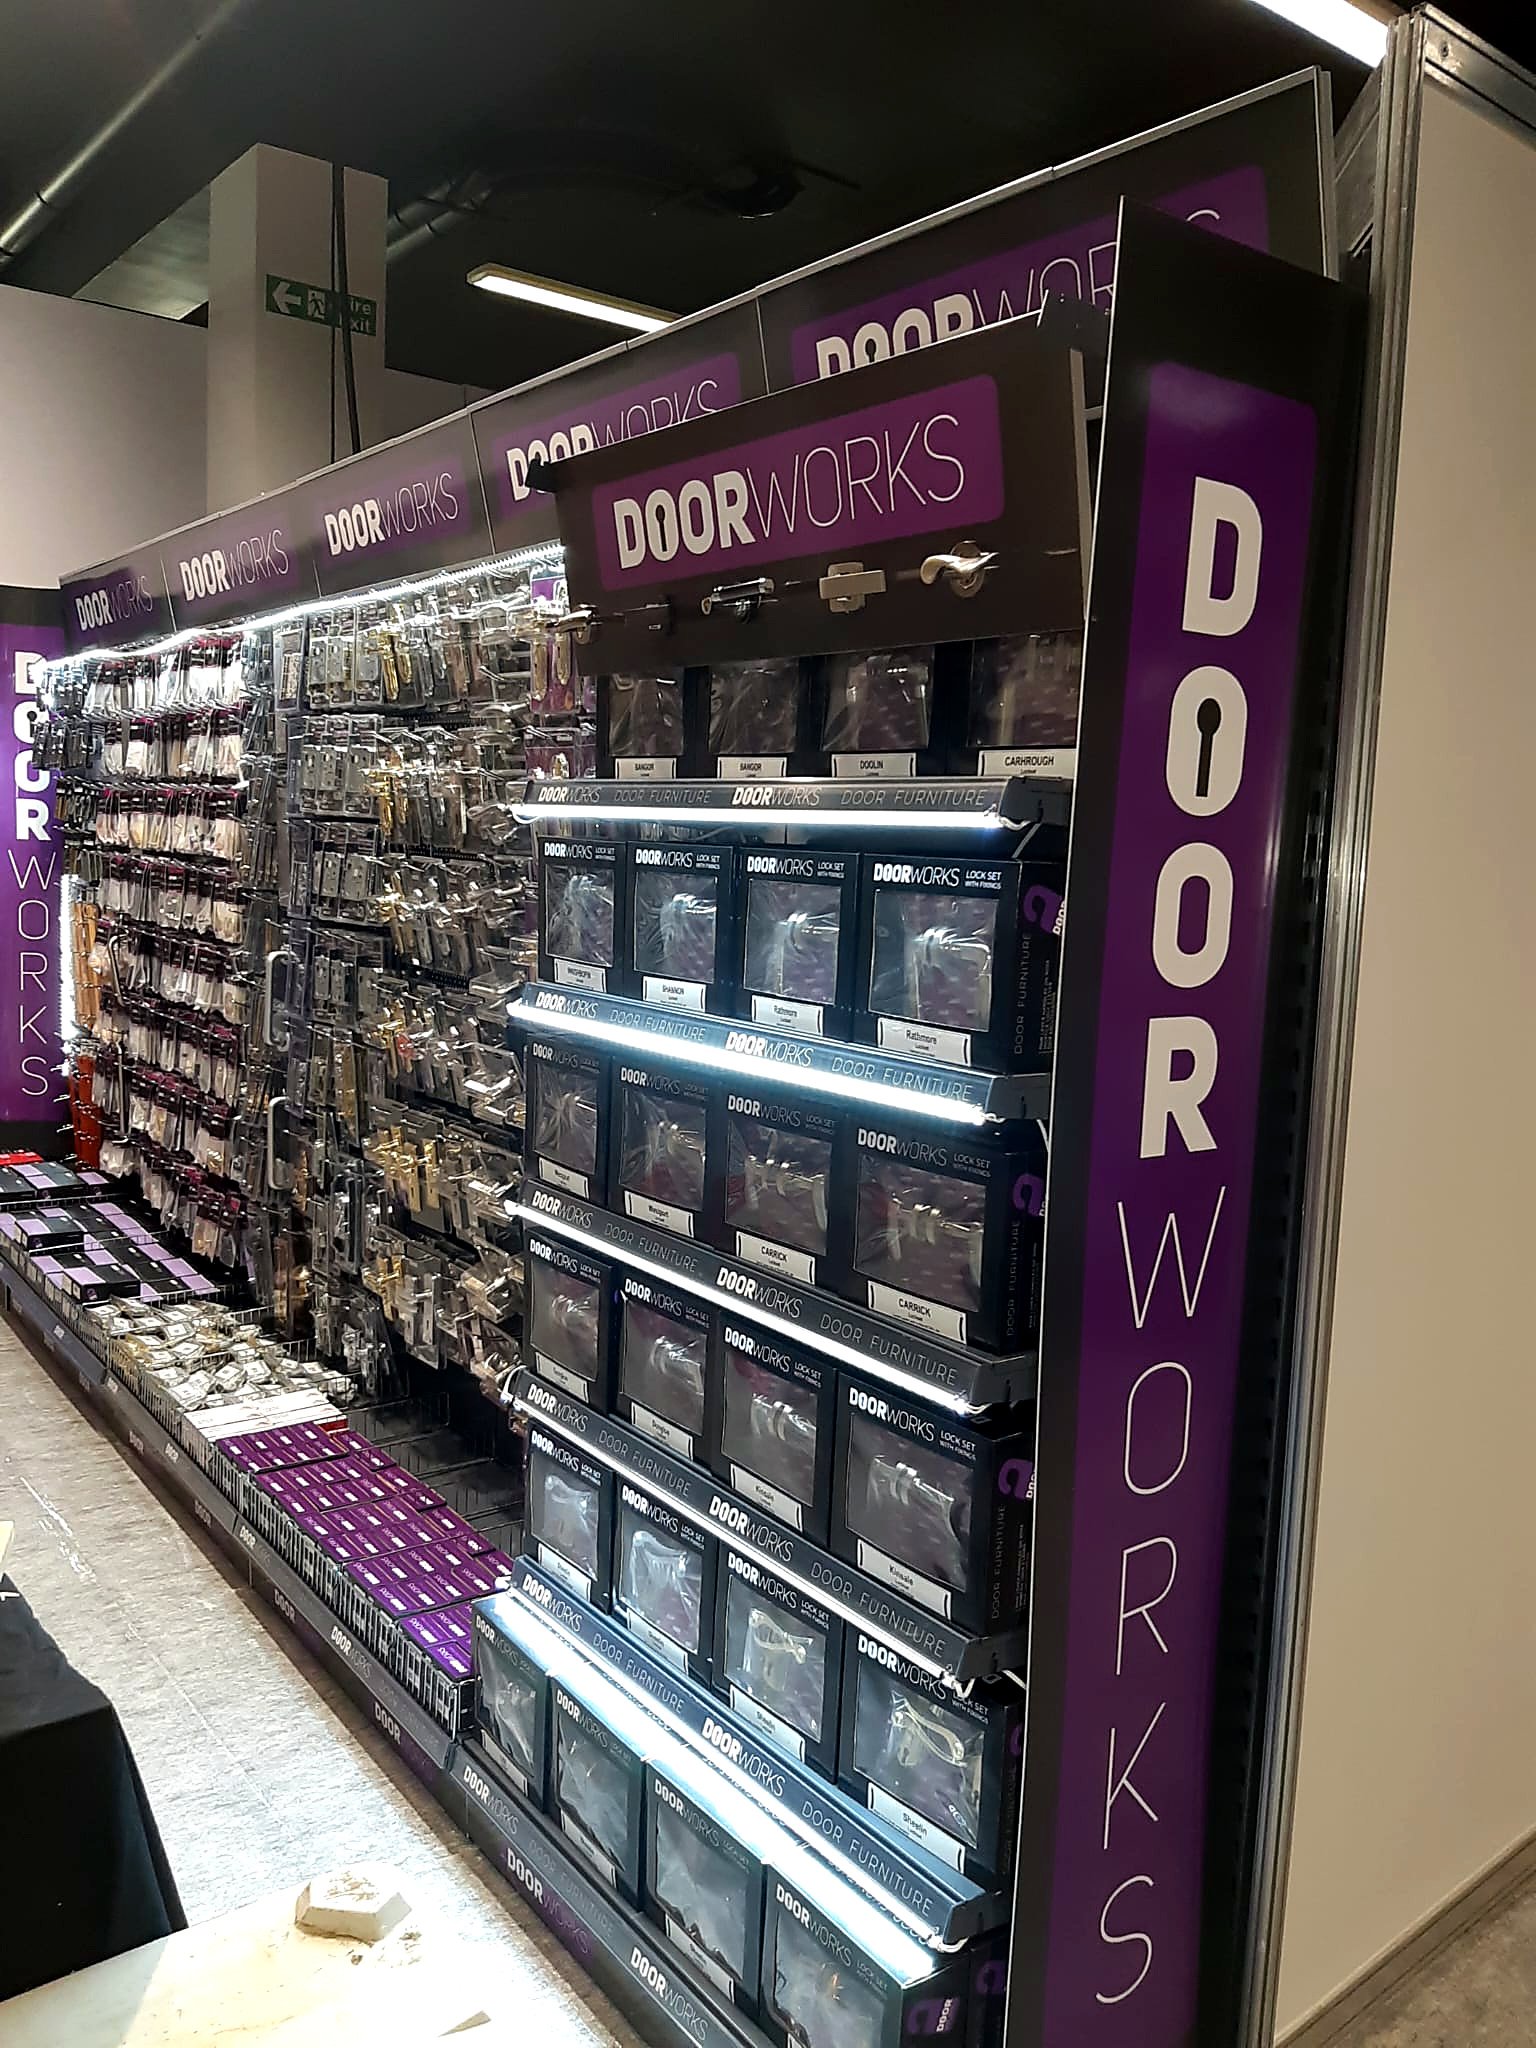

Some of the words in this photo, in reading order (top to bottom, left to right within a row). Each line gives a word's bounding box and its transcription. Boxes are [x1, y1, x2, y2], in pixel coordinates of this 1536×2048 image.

[613, 414, 964, 570] DOORWORKS
[324, 473, 458, 556] DOORWORKS
[179, 529, 289, 602] DOORWORKS
[76, 575, 153, 631] DOORWORKS
[860, 760, 884, 770] DOOLIN
[538, 786, 600, 803] DOORWORKS
[615, 790, 644, 802] DOOR
[650, 790, 712, 803] FURNITURE
[732, 787, 822, 806] DOORWORKS
[841, 790, 885, 805] DOOR
[894, 790, 988, 806] FURNITURE
[544, 842, 593, 860] DOORWORKS
[635, 849, 693, 868] DOORWORKS
[747, 856, 813, 876] DOORWORKS
[873, 864, 960, 887] DOORWORKS
[966, 870, 985, 880] LOCK
[986, 871, 1002, 882] SET
[536, 992, 599, 1019] DOORWORKS
[610, 1010, 640, 1027] DOOR
[645, 1017, 706, 1041] FURNITURE
[725, 1032, 814, 1067] DOORWORKS
[832, 1057, 876, 1080] DOOR
[882, 1068, 973, 1101] FURNITURE
[906, 1029, 937, 1045] Rathmore
[621, 1067, 680, 1094] DOORWORKS
[728, 1095, 801, 1127] DOORWORKS
[857, 1128, 947, 1167] DOORWORKS
[954, 1153, 974, 1166] LOCK
[975, 1157, 991, 1169] SET
[530, 1239, 578, 1273] DOORWORKS
[761, 1246, 787, 1262] CARRICK
[1096, 477, 1263, 2003] DOORWORKS
[532, 1190, 594, 1229] DOORWORKS
[605, 1223, 634, 1246] DOOR
[639, 1237, 698, 1272] FURNITURE
[717, 1267, 803, 1318] DOORWORKS
[820, 1313, 863, 1344] DOOR
[870, 1335, 959, 1386] FURNITURE
[625, 1278, 682, 1316] DOORWORKS
[898, 1298, 931, 1317] CARRICK
[725, 1327, 790, 1373] DOORWORKS
[794, 1362, 810, 1375] LOCK
[810, 1369, 822, 1380] SET
[850, 1387, 934, 1442] DOORWORKS
[532, 1431, 579, 1471] DOORWORKS
[941, 1431, 961, 1446] LOCK
[962, 1438, 976, 1452] SET
[528, 1384, 588, 1432] DOORWORKS
[599, 1431, 628, 1456] DOOR
[633, 1452, 691, 1496] FURNITURE
[710, 1496, 793, 1562] DOORWORKS
[811, 1563, 852, 1597] DOOR
[859, 1593, 946, 1658] FURNITURE
[622, 1485, 678, 1533] DOORWORKS
[728, 1552, 798, 1609] DOORWORKS
[802, 1600, 817, 1614] LOCK
[818, 1609, 830, 1621] SET
[858, 1635, 946, 1699] DOORWORKS
[556, 1689, 608, 1748] DOORWORKS
[975, 1703, 989, 1716] SET
[523, 1574, 583, 1632] DOORWORKS
[594, 1633, 622, 1663] DOOR
[626, 1657, 684, 1714] FURNITURE
[703, 1718, 786, 1797] DOORWORKS
[801, 1801, 843, 1844] DOOR
[850, 1839, 934, 1917] FURNITURE
[654, 1778, 721, 1848] DOORWORKS
[464, 1765, 520, 1835] DOORWORKS
[631, 1946, 709, 2042] DOORWORKS
[507, 1847, 589, 1954] DOORWORKS
[777, 1883, 852, 1967] DOORWORKS
